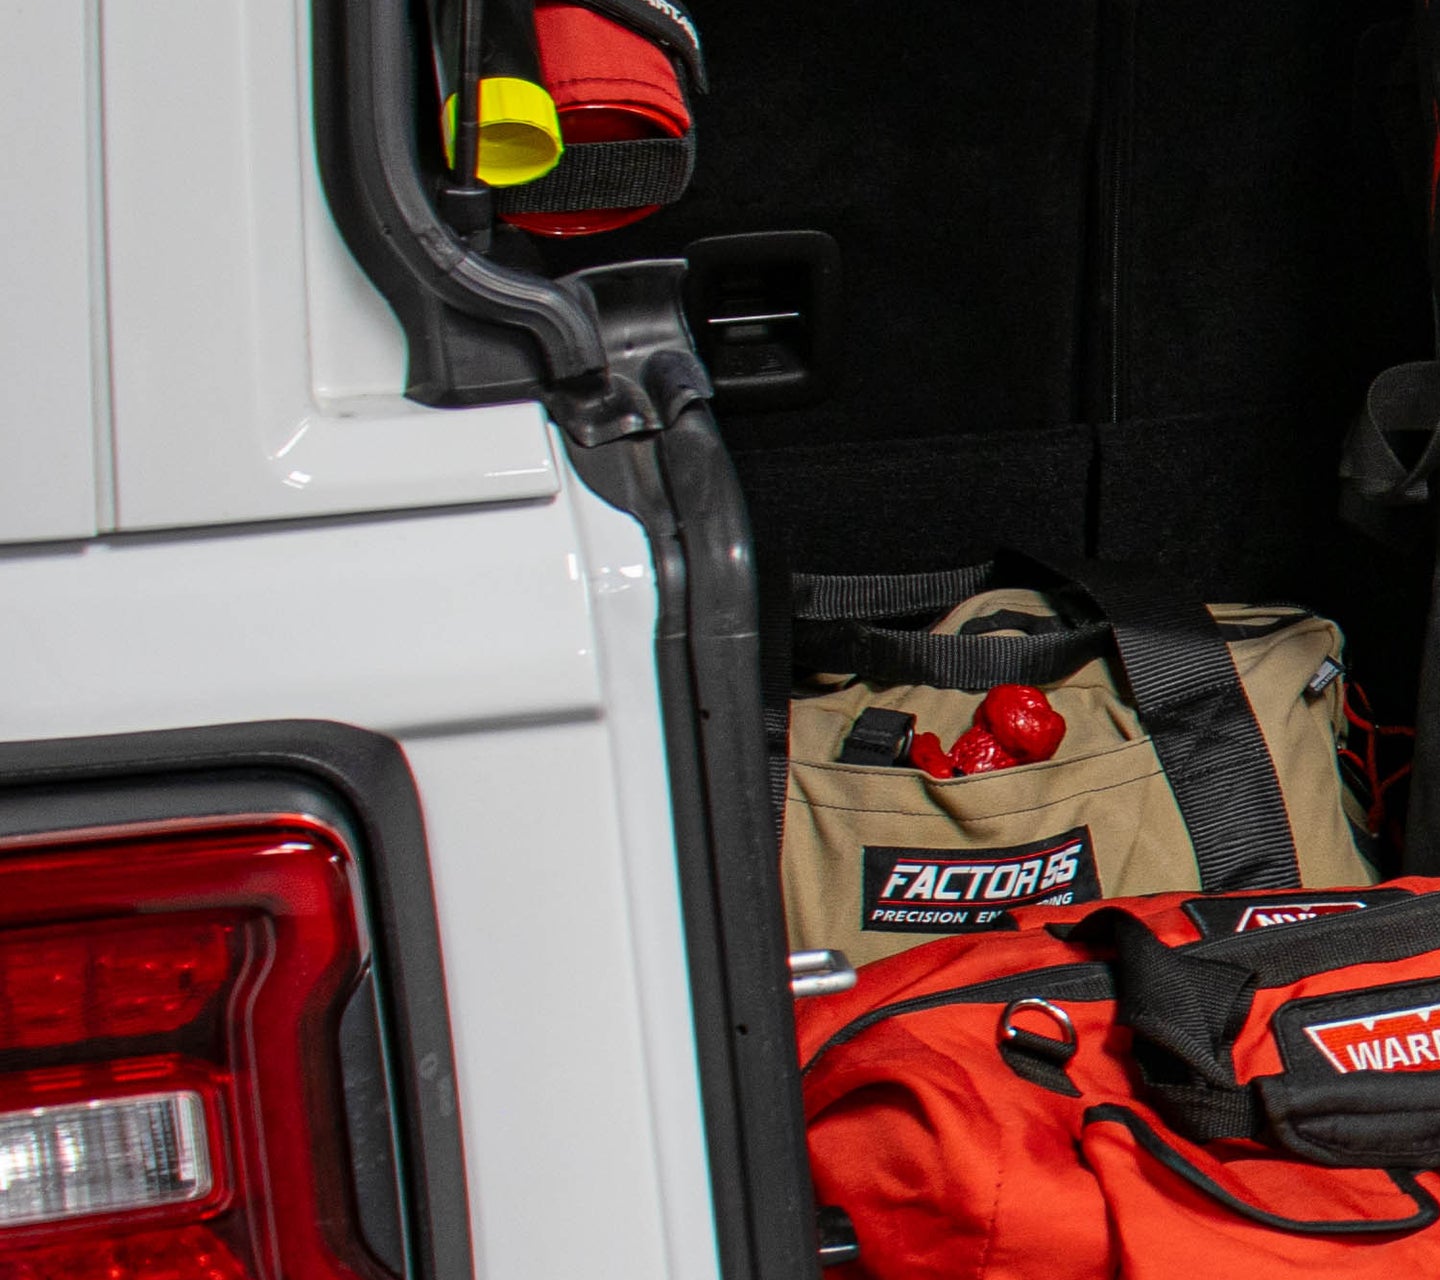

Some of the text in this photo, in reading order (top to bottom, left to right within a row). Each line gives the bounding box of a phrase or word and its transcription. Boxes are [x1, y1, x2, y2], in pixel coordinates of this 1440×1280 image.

[881, 844, 1083, 901] FACTOR 55
[871, 908, 969, 924] PRECISION
